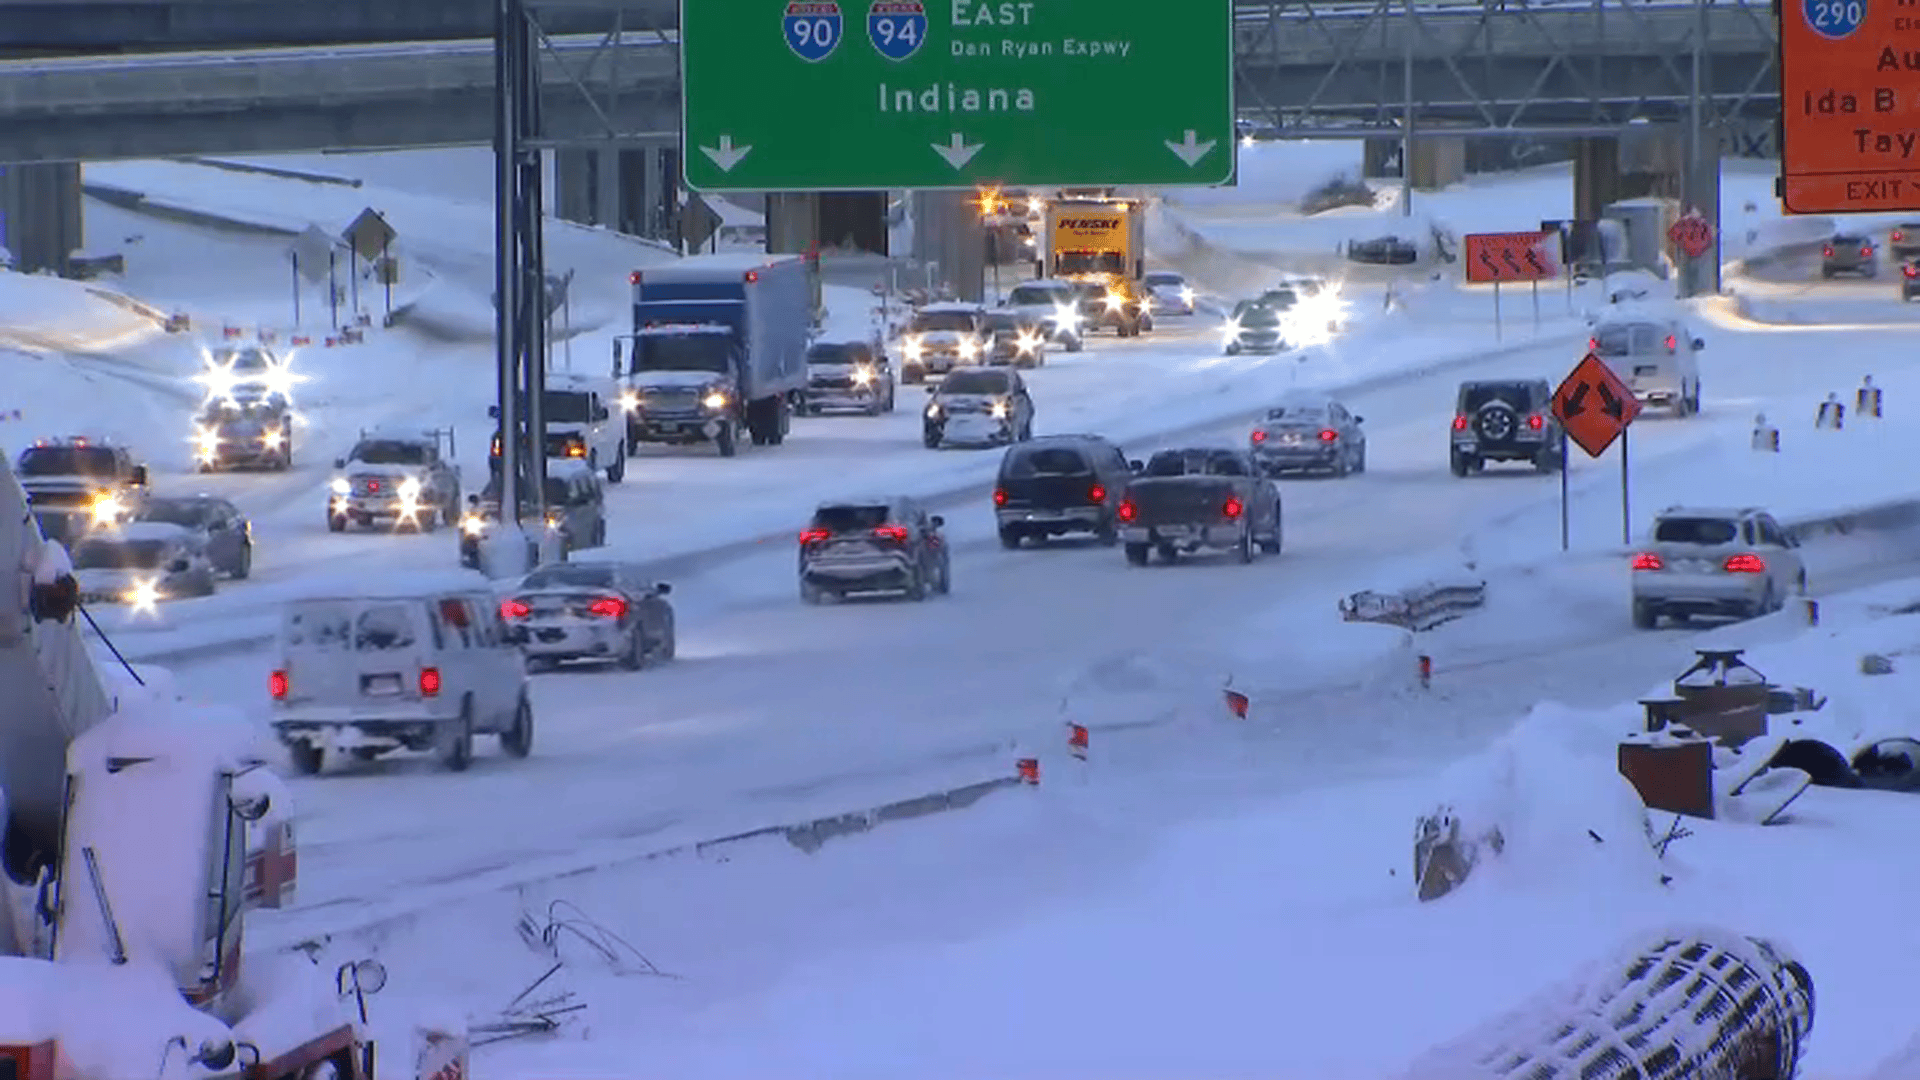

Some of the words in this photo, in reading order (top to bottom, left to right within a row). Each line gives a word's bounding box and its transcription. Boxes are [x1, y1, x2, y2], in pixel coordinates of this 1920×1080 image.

[952, 0, 1034, 25] EAST
[1814, 1, 1862, 26] 290
[794, 18, 832, 46] 90
[877, 18, 916, 46] 94
[951, 40, 991, 56] Dan
[1002, 39, 1053, 59] Ryan
[1063, 38, 1130, 58] Expwy
[880, 83, 1036, 112] Indiana
[1804, 88, 1857, 116] Ida
[1875, 87, 1895, 114] B
[1846, 179, 1903, 201] EXIT
